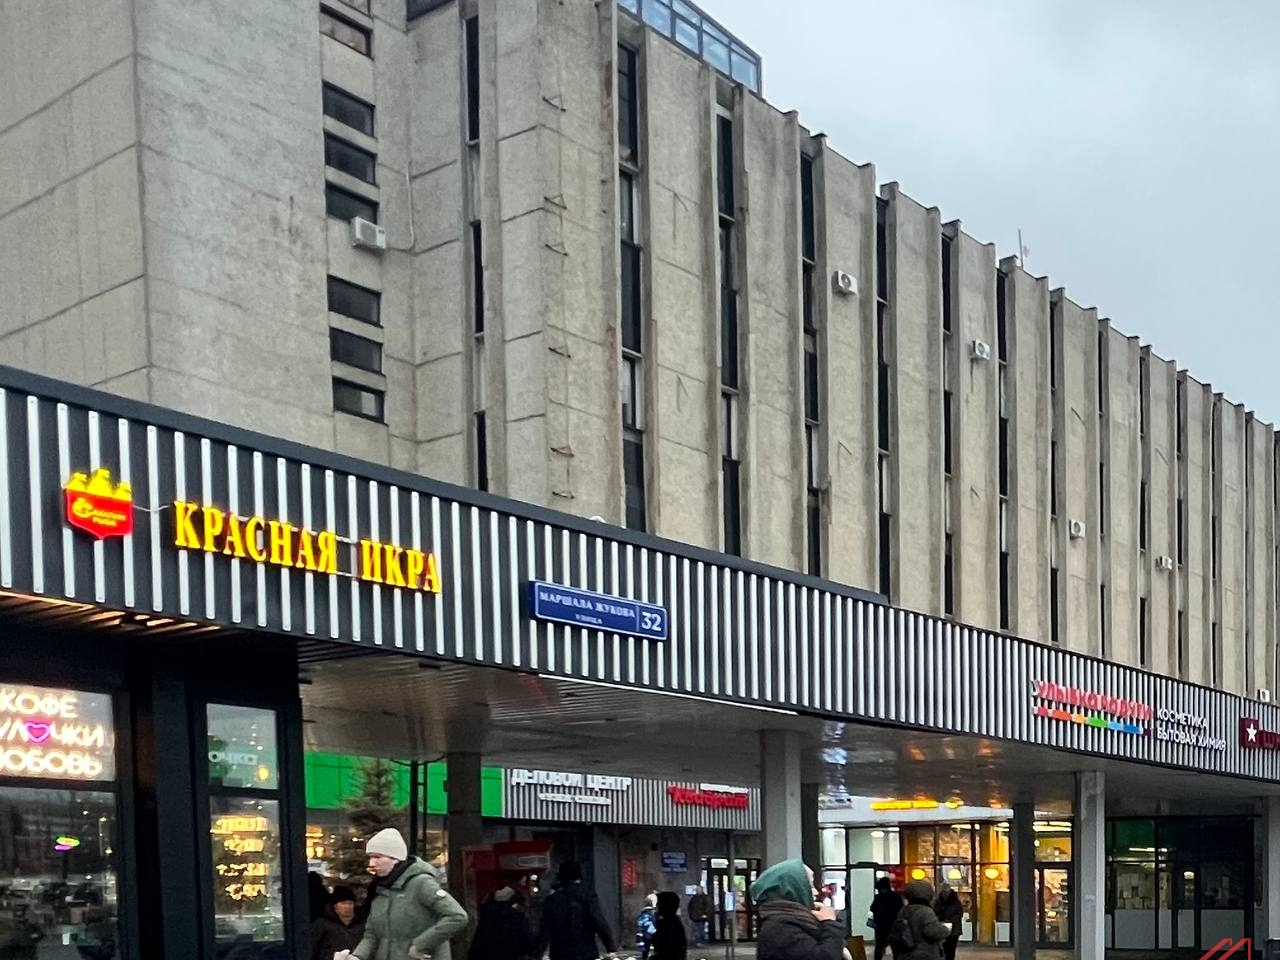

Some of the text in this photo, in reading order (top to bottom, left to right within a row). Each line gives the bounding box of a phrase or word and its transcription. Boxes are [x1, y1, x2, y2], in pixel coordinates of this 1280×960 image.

[173, 501, 442, 594] КРАСНАЯ ИКРА
[539, 591, 635, 618] МАРШАЛА ЖУКОВА
[641, 611, 662, 632] 32
[0, 688, 78, 718] КОФЕ
[1156, 708, 1209, 729] КОСМЕТИКА
[1156, 727, 1227, 752] БЫТОВАЯ ХИМИЯ
